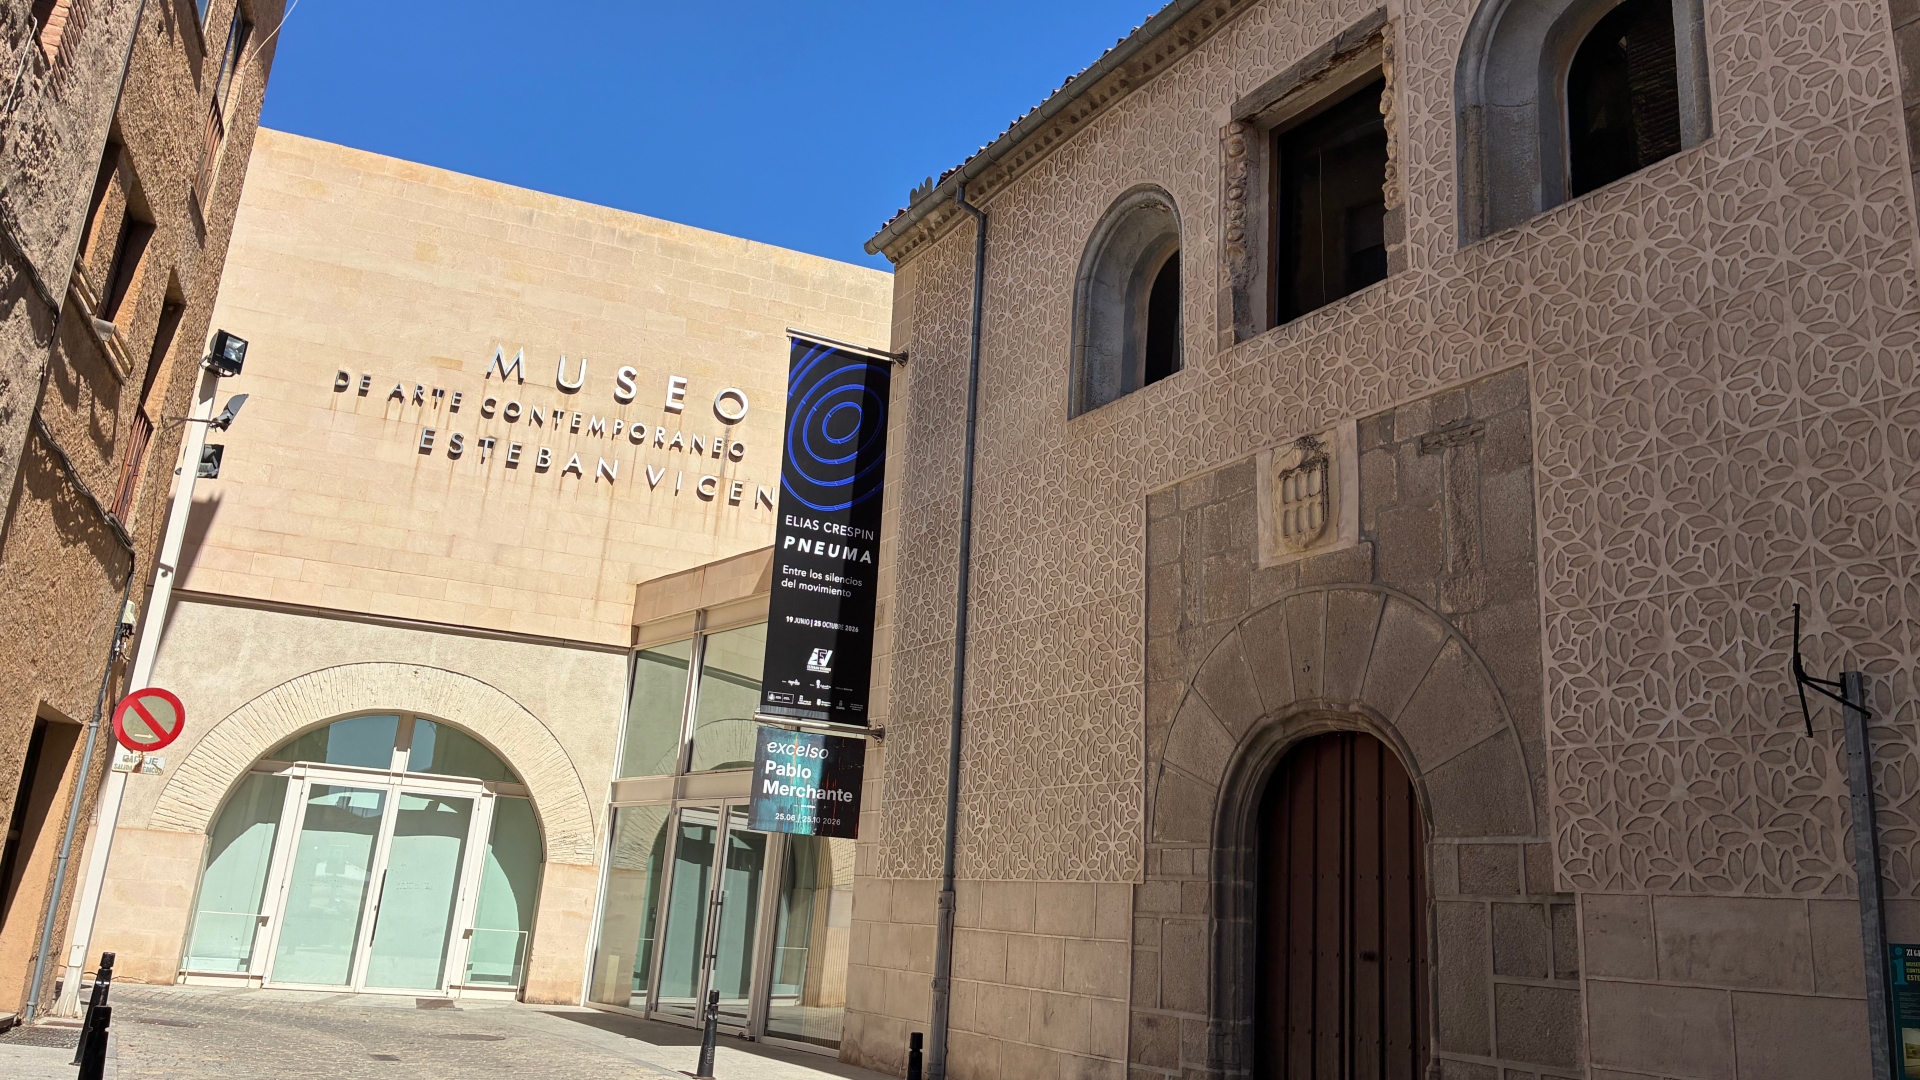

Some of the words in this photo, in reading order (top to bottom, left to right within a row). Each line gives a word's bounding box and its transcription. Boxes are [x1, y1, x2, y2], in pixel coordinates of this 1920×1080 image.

[486, 343, 749, 421] MUSEO
[334, 369, 371, 391] DE
[387, 381, 463, 407] ARTE
[482, 397, 745, 458] CONTEMPORANEO
[420, 427, 619, 479] ESTEBAN
[785, 514, 820, 531] ELIAS
[823, 522, 874, 540] CRESPIN
[783, 535, 872, 564] PNEUMA
[782, 564, 807, 577] Entre
[809, 568, 823, 580] los
[825, 572, 863, 587] silencios
[781, 578, 796, 589] del
[798, 582, 852, 597] movimiento
[785, 615, 794, 623] 19
[794, 617, 810, 626] JUNIO
[822, 621, 844, 631] OCTUBRE
[844, 625, 859, 633] 2026
[766, 741, 829, 760] excelso
[765, 760, 812, 779] Pablo
[762, 779, 853, 802] Merchante
[802, 815, 821, 824] 25.10
[822, 817, 841, 826] 2026
